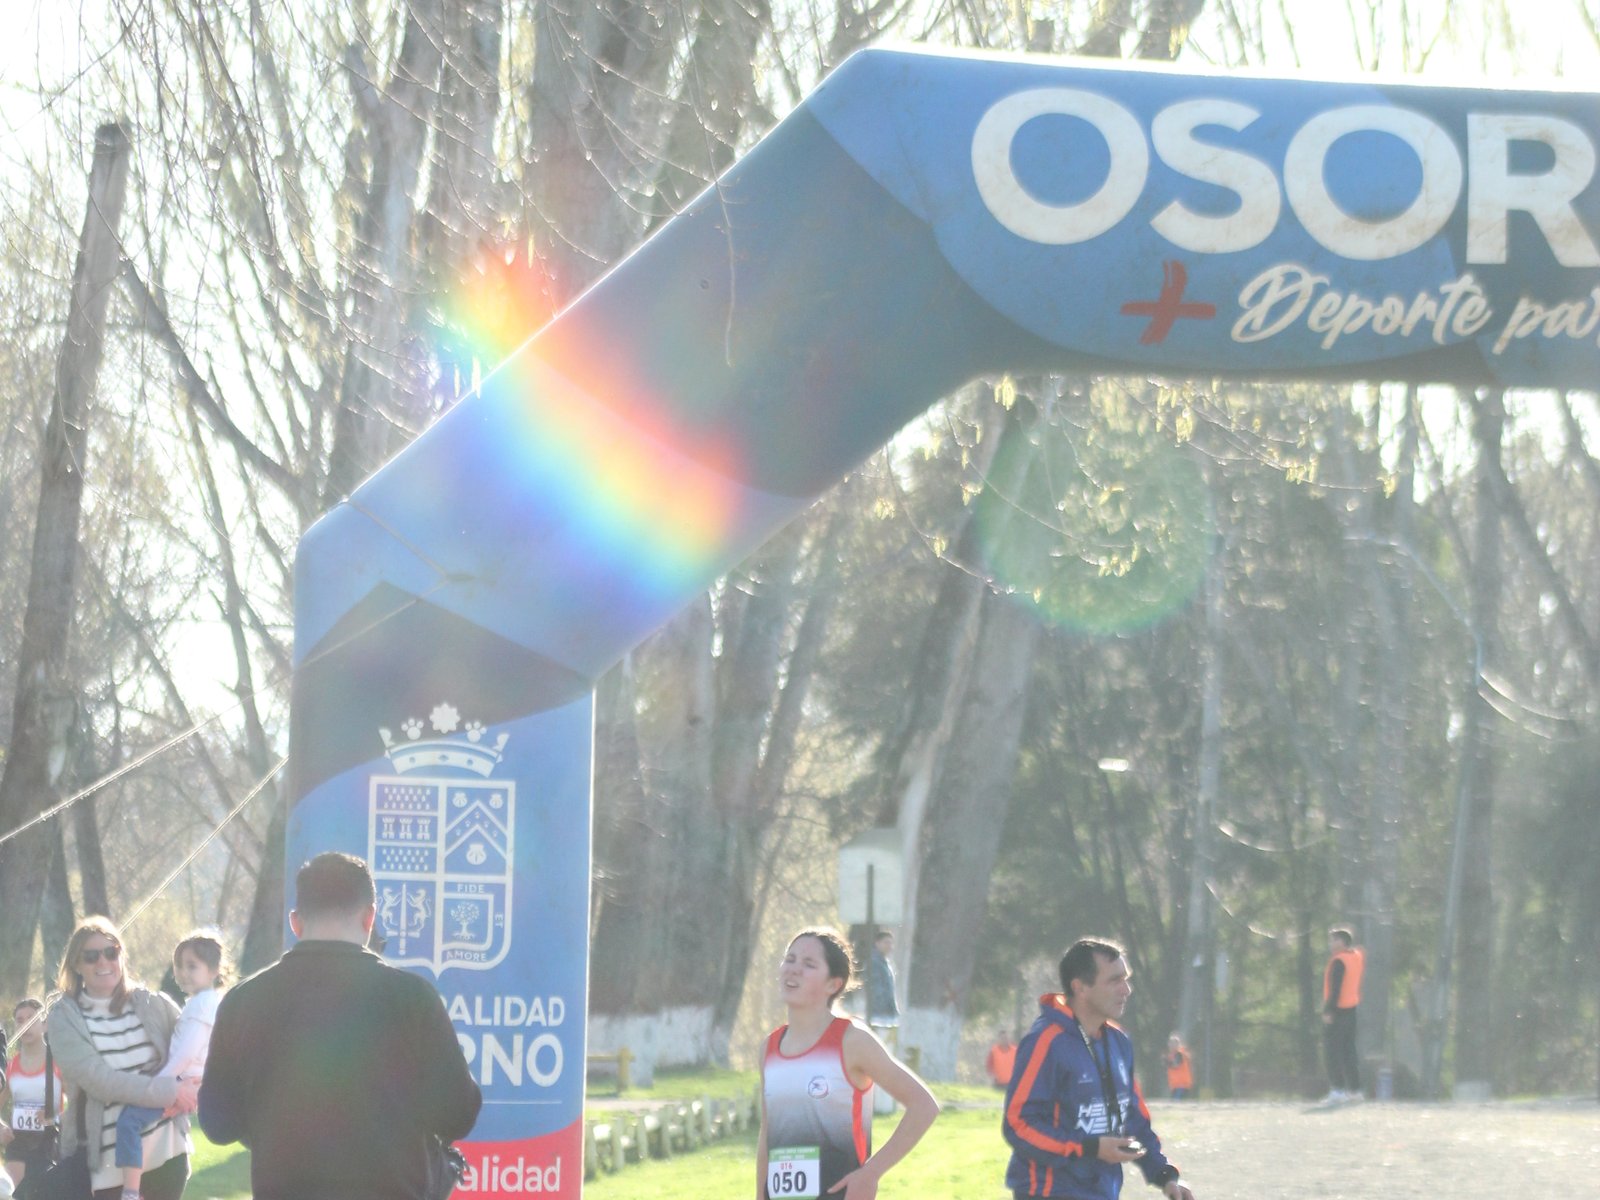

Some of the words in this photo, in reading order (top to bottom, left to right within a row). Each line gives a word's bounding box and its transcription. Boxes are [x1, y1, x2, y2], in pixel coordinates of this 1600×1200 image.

[971, 87, 1600, 268] OSOR
[1231, 263, 1493, 351] Deporte
[1492, 286, 1600, 355] pa
[456, 883, 486, 894] FIDE
[446, 950, 487, 962] AMORE
[440, 993, 566, 1027] ALIDAD
[772, 1170, 807, 1194] 050
